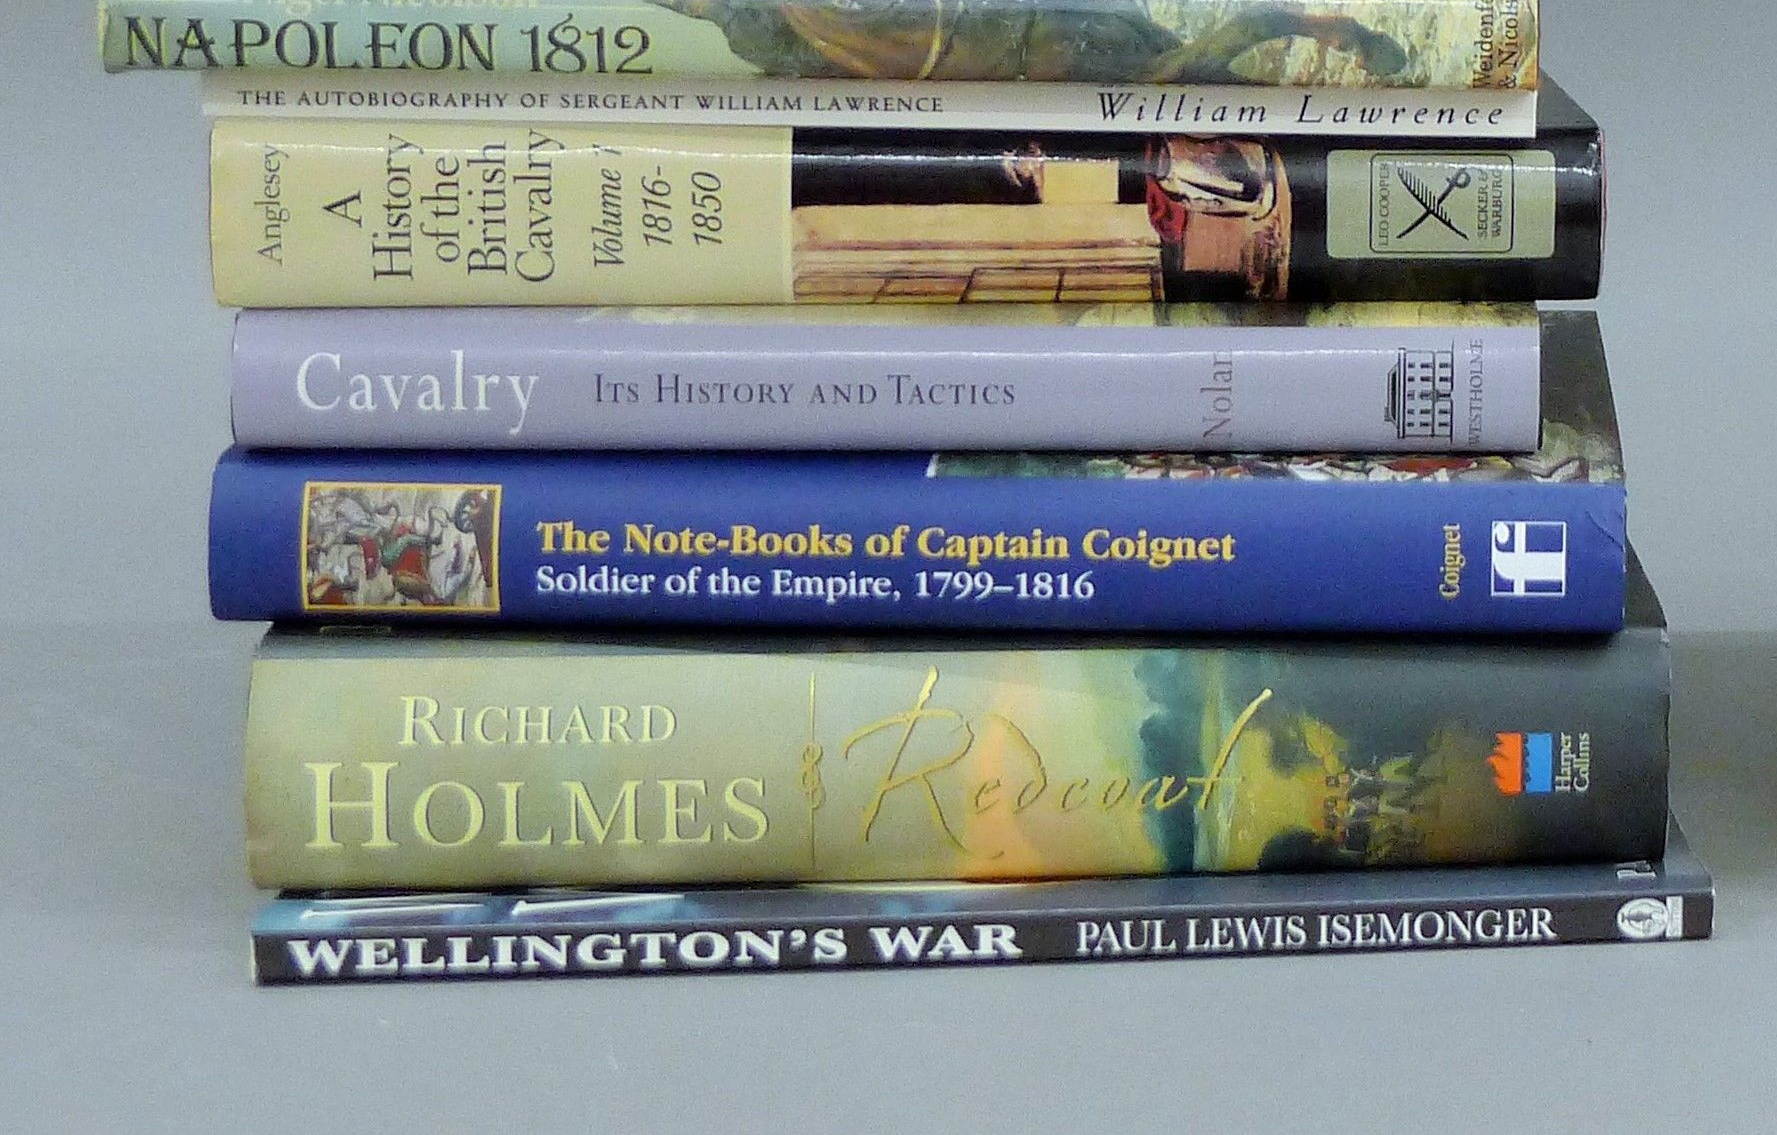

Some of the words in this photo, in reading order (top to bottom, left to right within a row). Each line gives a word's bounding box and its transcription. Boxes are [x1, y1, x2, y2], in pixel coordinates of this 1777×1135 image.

[124, 15, 500, 72] NAPOLEON
[519, 13, 654, 75] 1812
[238, 89, 287, 108] THE
[298, 89, 509, 110] AUTOBIOGRAPHY
[519, 91, 551, 110] OF
[559, 92, 685, 112] SERGEANT
[696, 93, 805, 113] WILLIAM
[813, 95, 945, 114] LAWRENCE
[1097, 91, 1269, 124] William
[1296, 95, 1506, 127] Lawrence
[255, 142, 292, 267] Anglesey
[323, 188, 363, 228] A
[371, 133, 426, 282] History
[424, 155, 462, 215] the
[467, 139, 508, 277] British
[514, 128, 566, 284] Cavalry
[592, 167, 624, 271] Volume
[641, 165, 674, 247] 1816-
[694, 170, 725, 248] 1850
[1477, 186, 1490, 241] SECKER
[420, 220, 462, 264] of
[295, 349, 540, 435] Cavalry
[594, 372, 639, 406] ITS
[655, 372, 796, 407] HISTORY
[809, 379, 878, 406] AND
[886, 373, 1017, 407] TACTICS
[1199, 351, 1235, 442] Nolan
[1467, 338, 1485, 447] WESTHOLME
[535, 519, 614, 556] The
[622, 522, 852, 559] Note-Books
[864, 523, 911, 559] of
[916, 526, 1071, 567] Captain
[1081, 528, 1237, 568] Coignet
[1438, 522, 1463, 601] Coignet
[535, 565, 656, 597] Soldier
[664, 565, 705, 597] of
[706, 567, 763, 598] the
[771, 569, 902, 607] Empire,
[398, 694, 679, 747] RICHARD
[843, 665, 1273, 859] Redcoat
[1554, 731, 1573, 794] Harper
[1573, 731, 1591, 794] Collins
[304, 761, 771, 850] HOLMES
[287, 927, 850, 978] WELLINGTON'S
[868, 923, 1024, 961] WAR
[1076, 919, 1177, 955] PAUL
[1185, 916, 1308, 952] LEWIS
[1316, 907, 1559, 949] ISEMONGER
